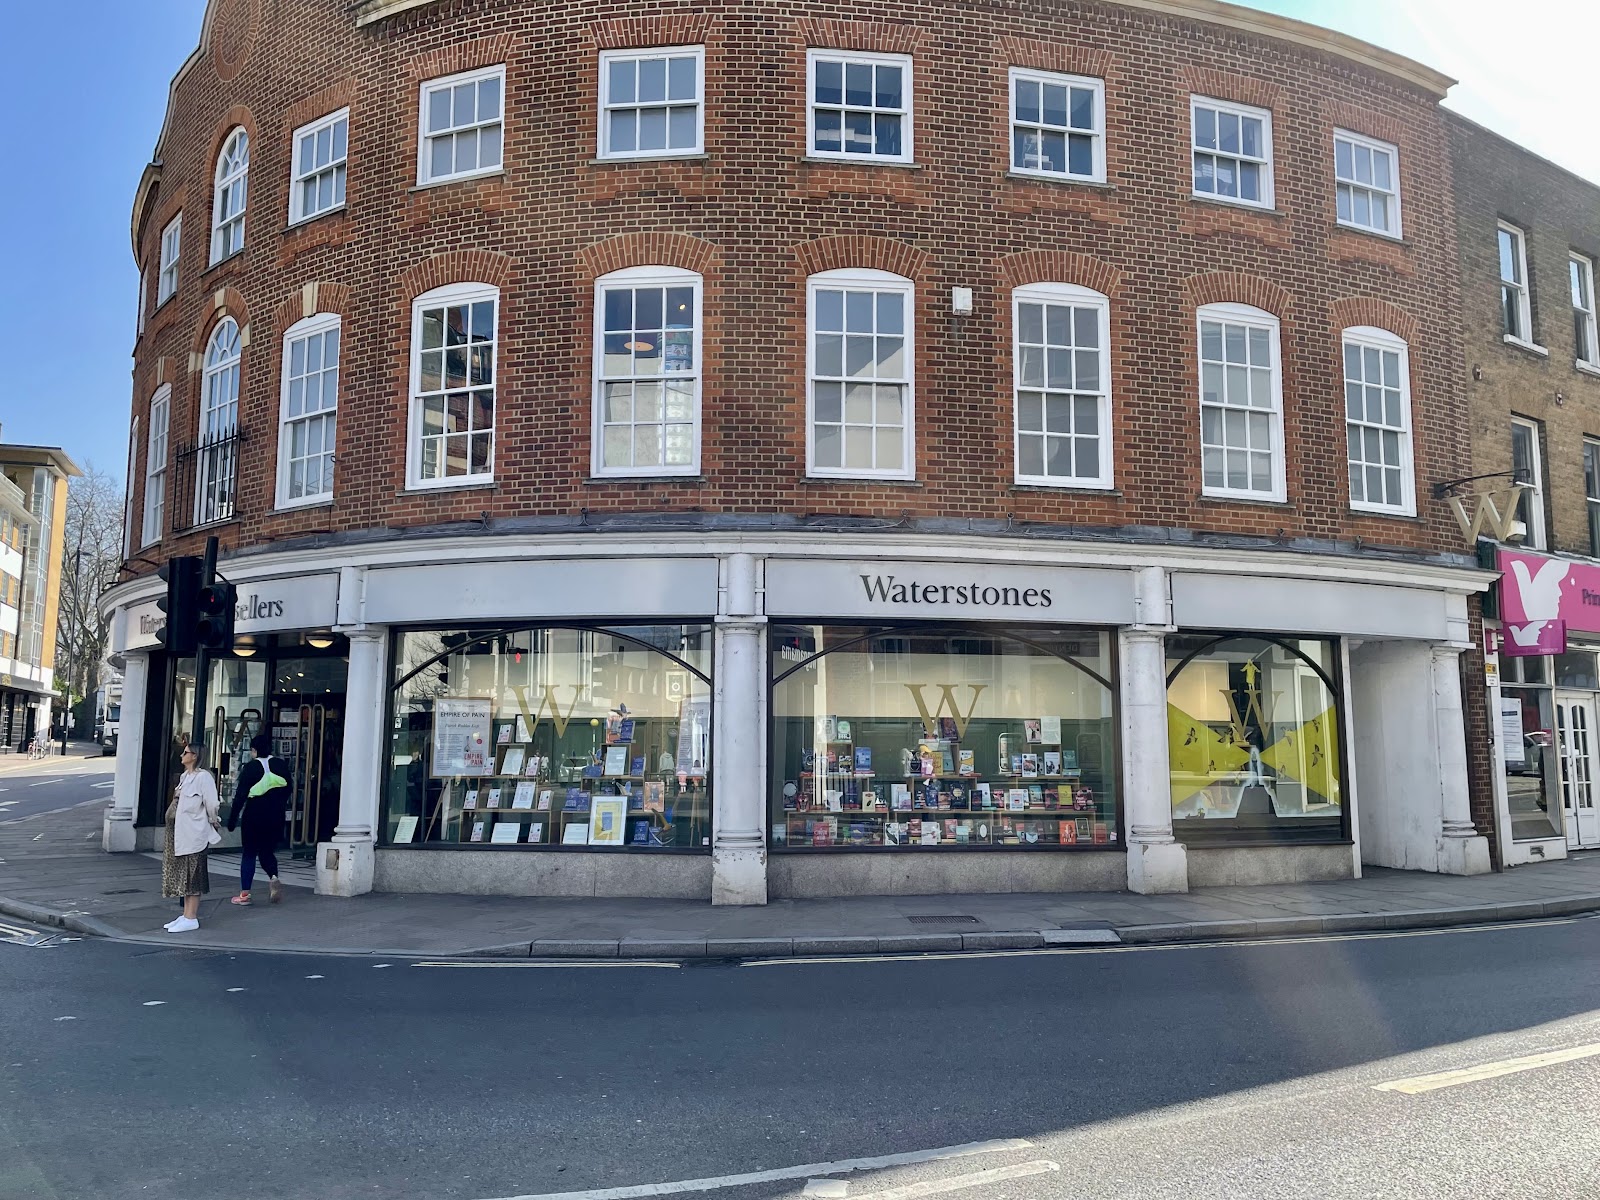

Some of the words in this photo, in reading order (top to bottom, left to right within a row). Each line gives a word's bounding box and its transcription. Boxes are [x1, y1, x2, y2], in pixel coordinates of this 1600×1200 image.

[1444, 486, 1525, 545] W
[140, 614, 167, 635] Waters
[234, 594, 284, 622] sellers
[860, 574, 1053, 608] Waterstones
[512, 683, 587, 739] W
[903, 683, 989, 740] W
[1218, 688, 1284, 742] W
